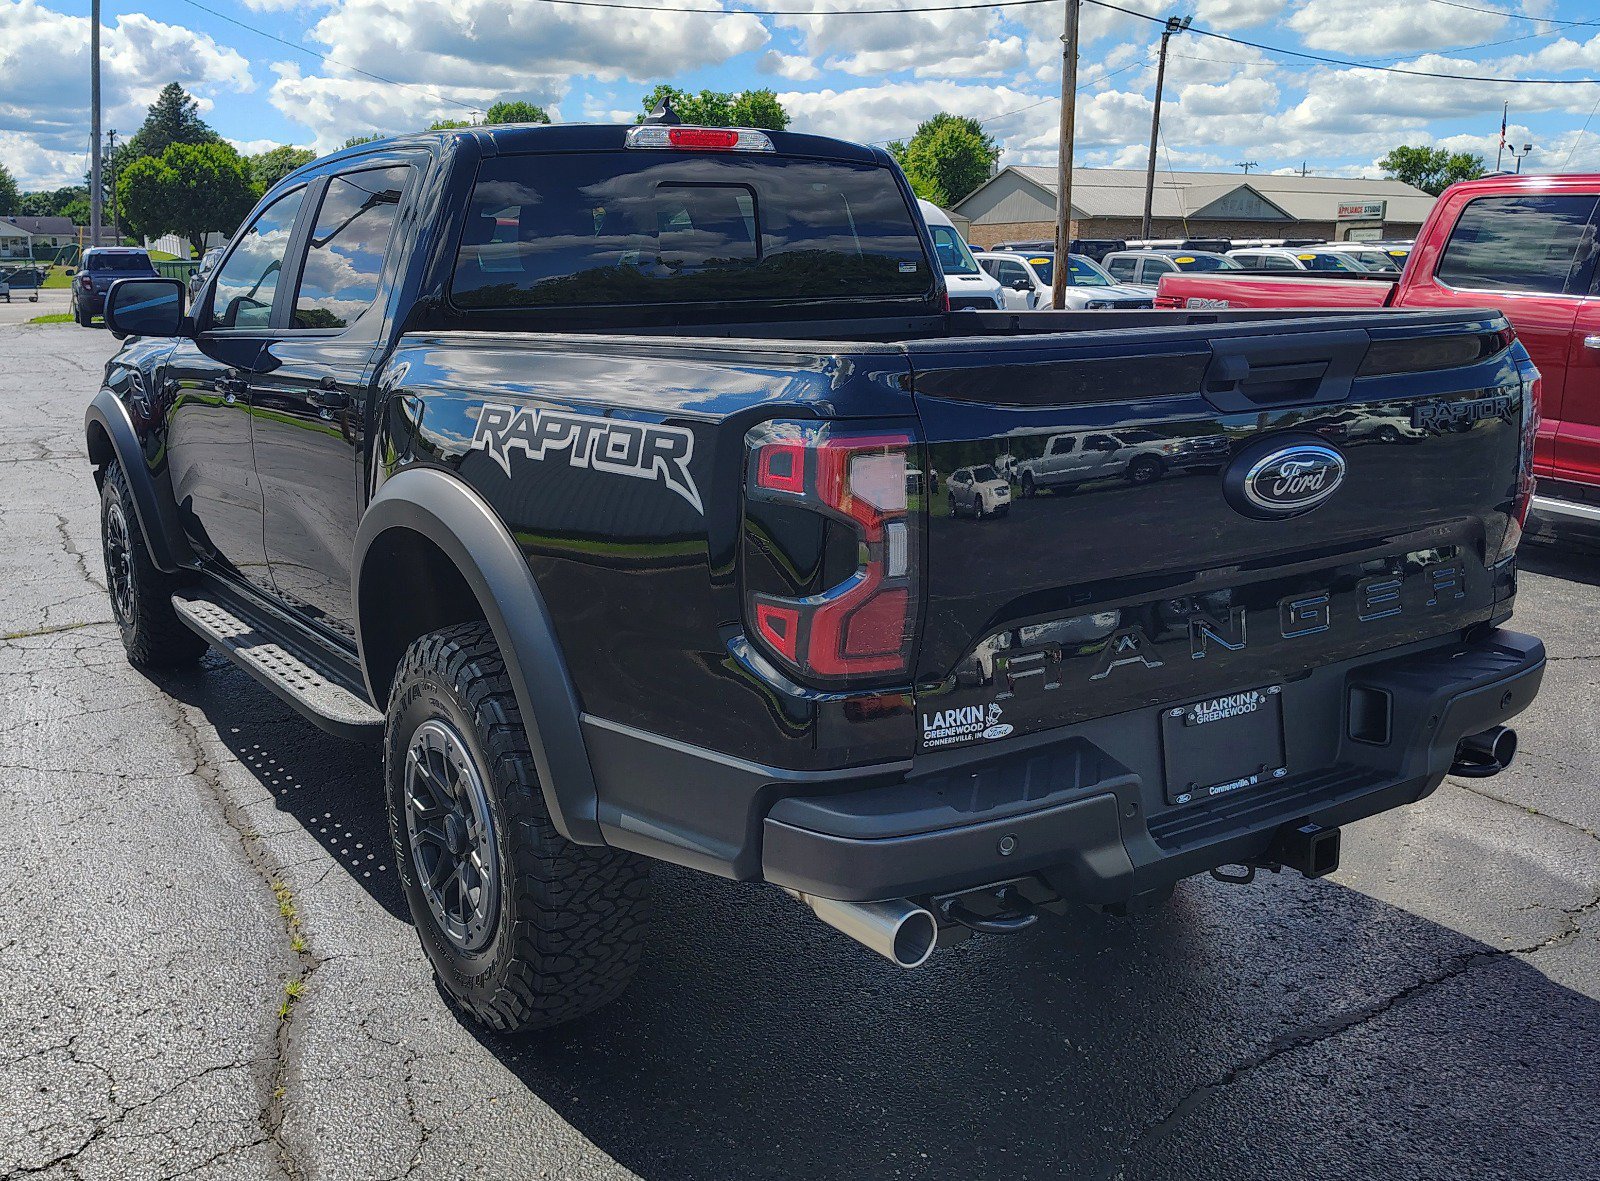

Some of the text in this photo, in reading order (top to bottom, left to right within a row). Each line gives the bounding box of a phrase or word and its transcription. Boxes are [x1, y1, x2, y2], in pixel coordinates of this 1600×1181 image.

[1187, 297, 1229, 310] FX4
[1411, 396, 1513, 437] RAPTOR
[471, 402, 704, 516] RAPTOR
[1273, 460, 1325, 496] Ford
[994, 566, 1468, 700] RANGER
[1196, 702, 1257, 724] GREENEWOOD
[1203, 692, 1251, 714] LARKIN
[923, 704, 984, 731] LARKIN
[923, 723, 984, 740] GREENEWOOD
[923, 735, 974, 747] CONNERSVILLE,
[1250, 775, 1258, 785] IN
